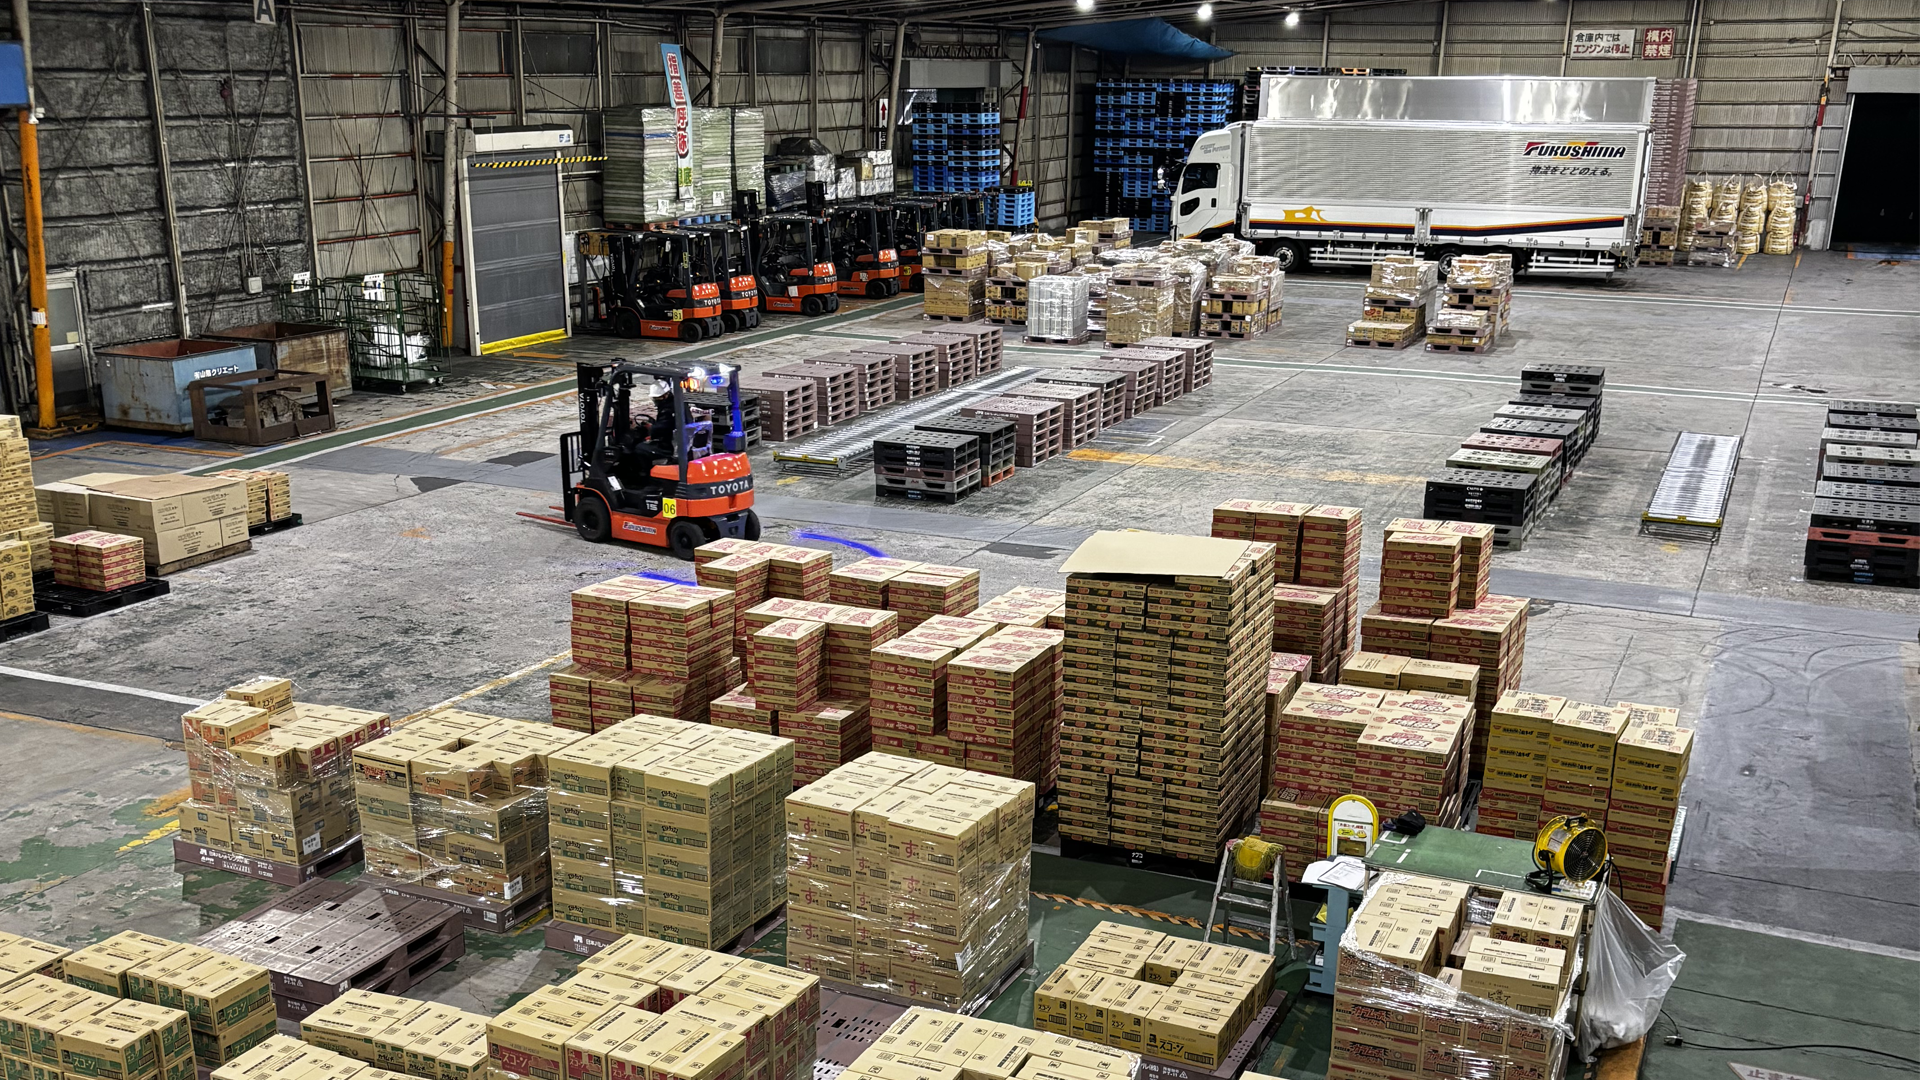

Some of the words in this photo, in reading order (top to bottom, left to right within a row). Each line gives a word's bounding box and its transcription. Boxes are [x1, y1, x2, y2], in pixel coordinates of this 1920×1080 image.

[1575, 32, 1621, 42] 倉庫内では
[1645, 28, 1673, 42] 構内
[1573, 44, 1630, 54] エンジンは停止
[1644, 44, 1672, 57] 禁煙
[1523, 144, 1626, 158] FUKUSHIMA
[710, 481, 749, 495] TOYOTA
[663, 503, 676, 515] 06
[226, 1001, 247, 1018] スコーン
[1159, 1040, 1184, 1053] スコーン
[73, 1057, 95, 1070] スコーン
[502, 1051, 528, 1068] スコーン
